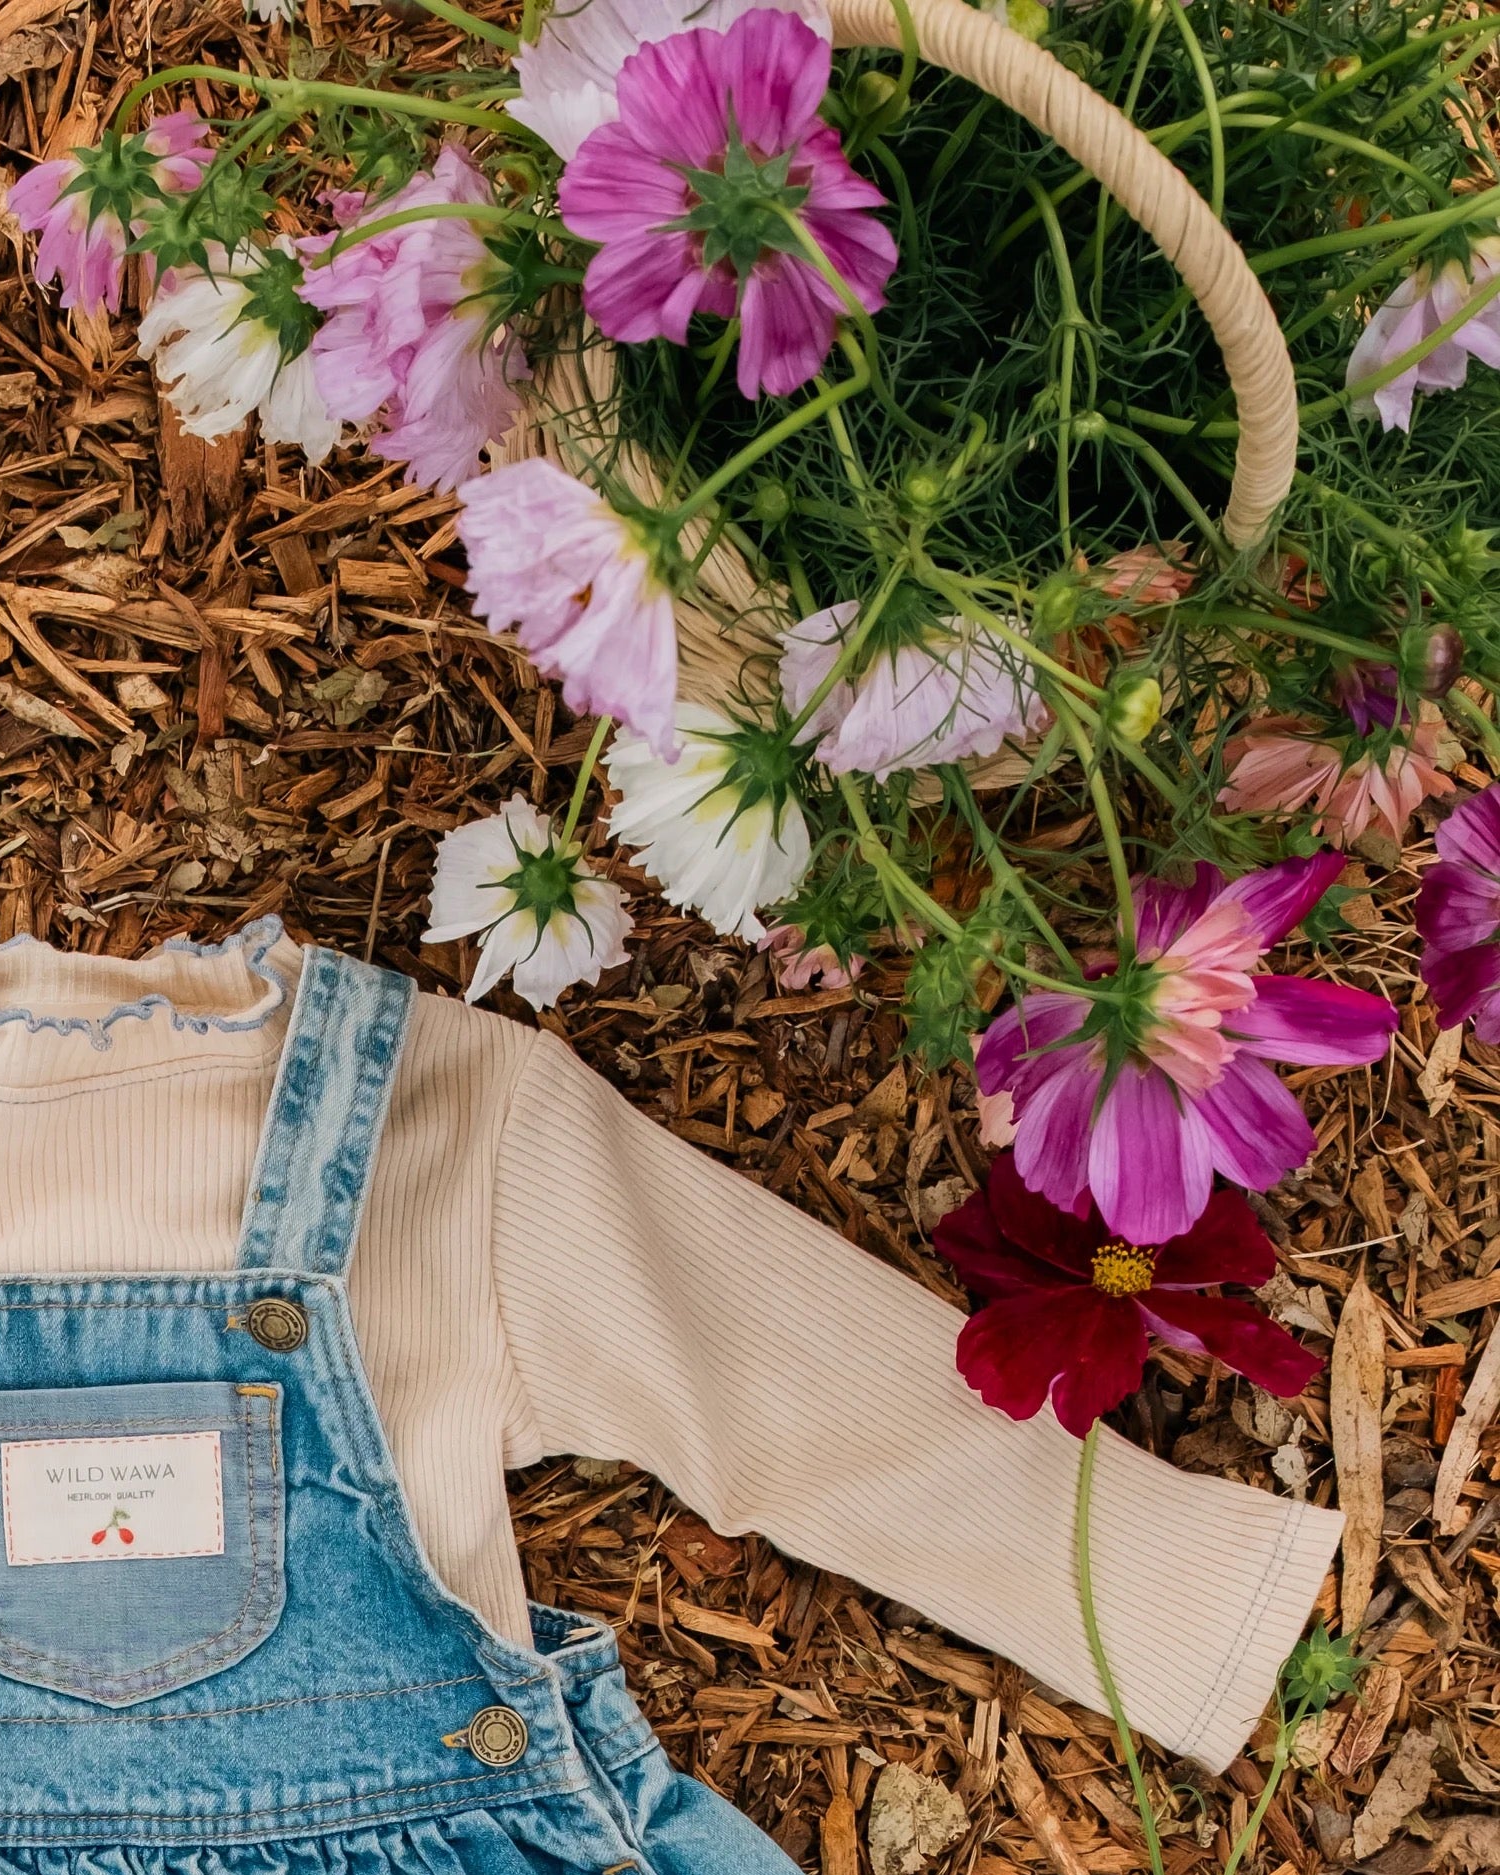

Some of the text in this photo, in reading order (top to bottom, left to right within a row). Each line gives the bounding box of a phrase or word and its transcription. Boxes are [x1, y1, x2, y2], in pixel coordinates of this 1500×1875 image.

[46, 1463, 176, 1484] WILD WAWA
[116, 1489, 156, 1500] QUALITY
